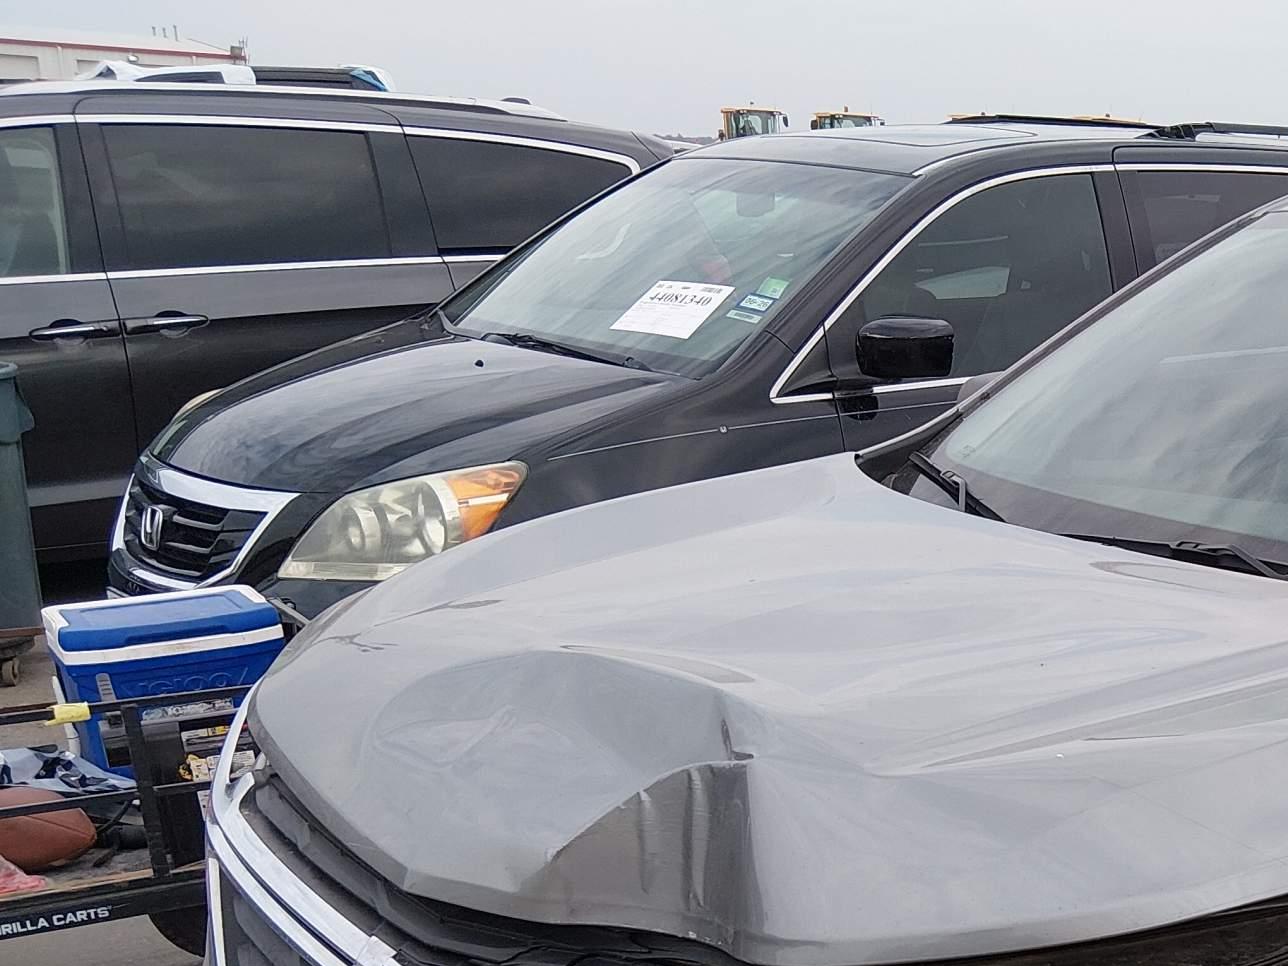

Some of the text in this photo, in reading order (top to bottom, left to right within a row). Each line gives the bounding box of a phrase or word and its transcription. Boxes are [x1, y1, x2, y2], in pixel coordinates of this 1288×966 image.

[649, 292, 713, 306] 44081340
[0, 906, 111, 936] RILLA CARTS
